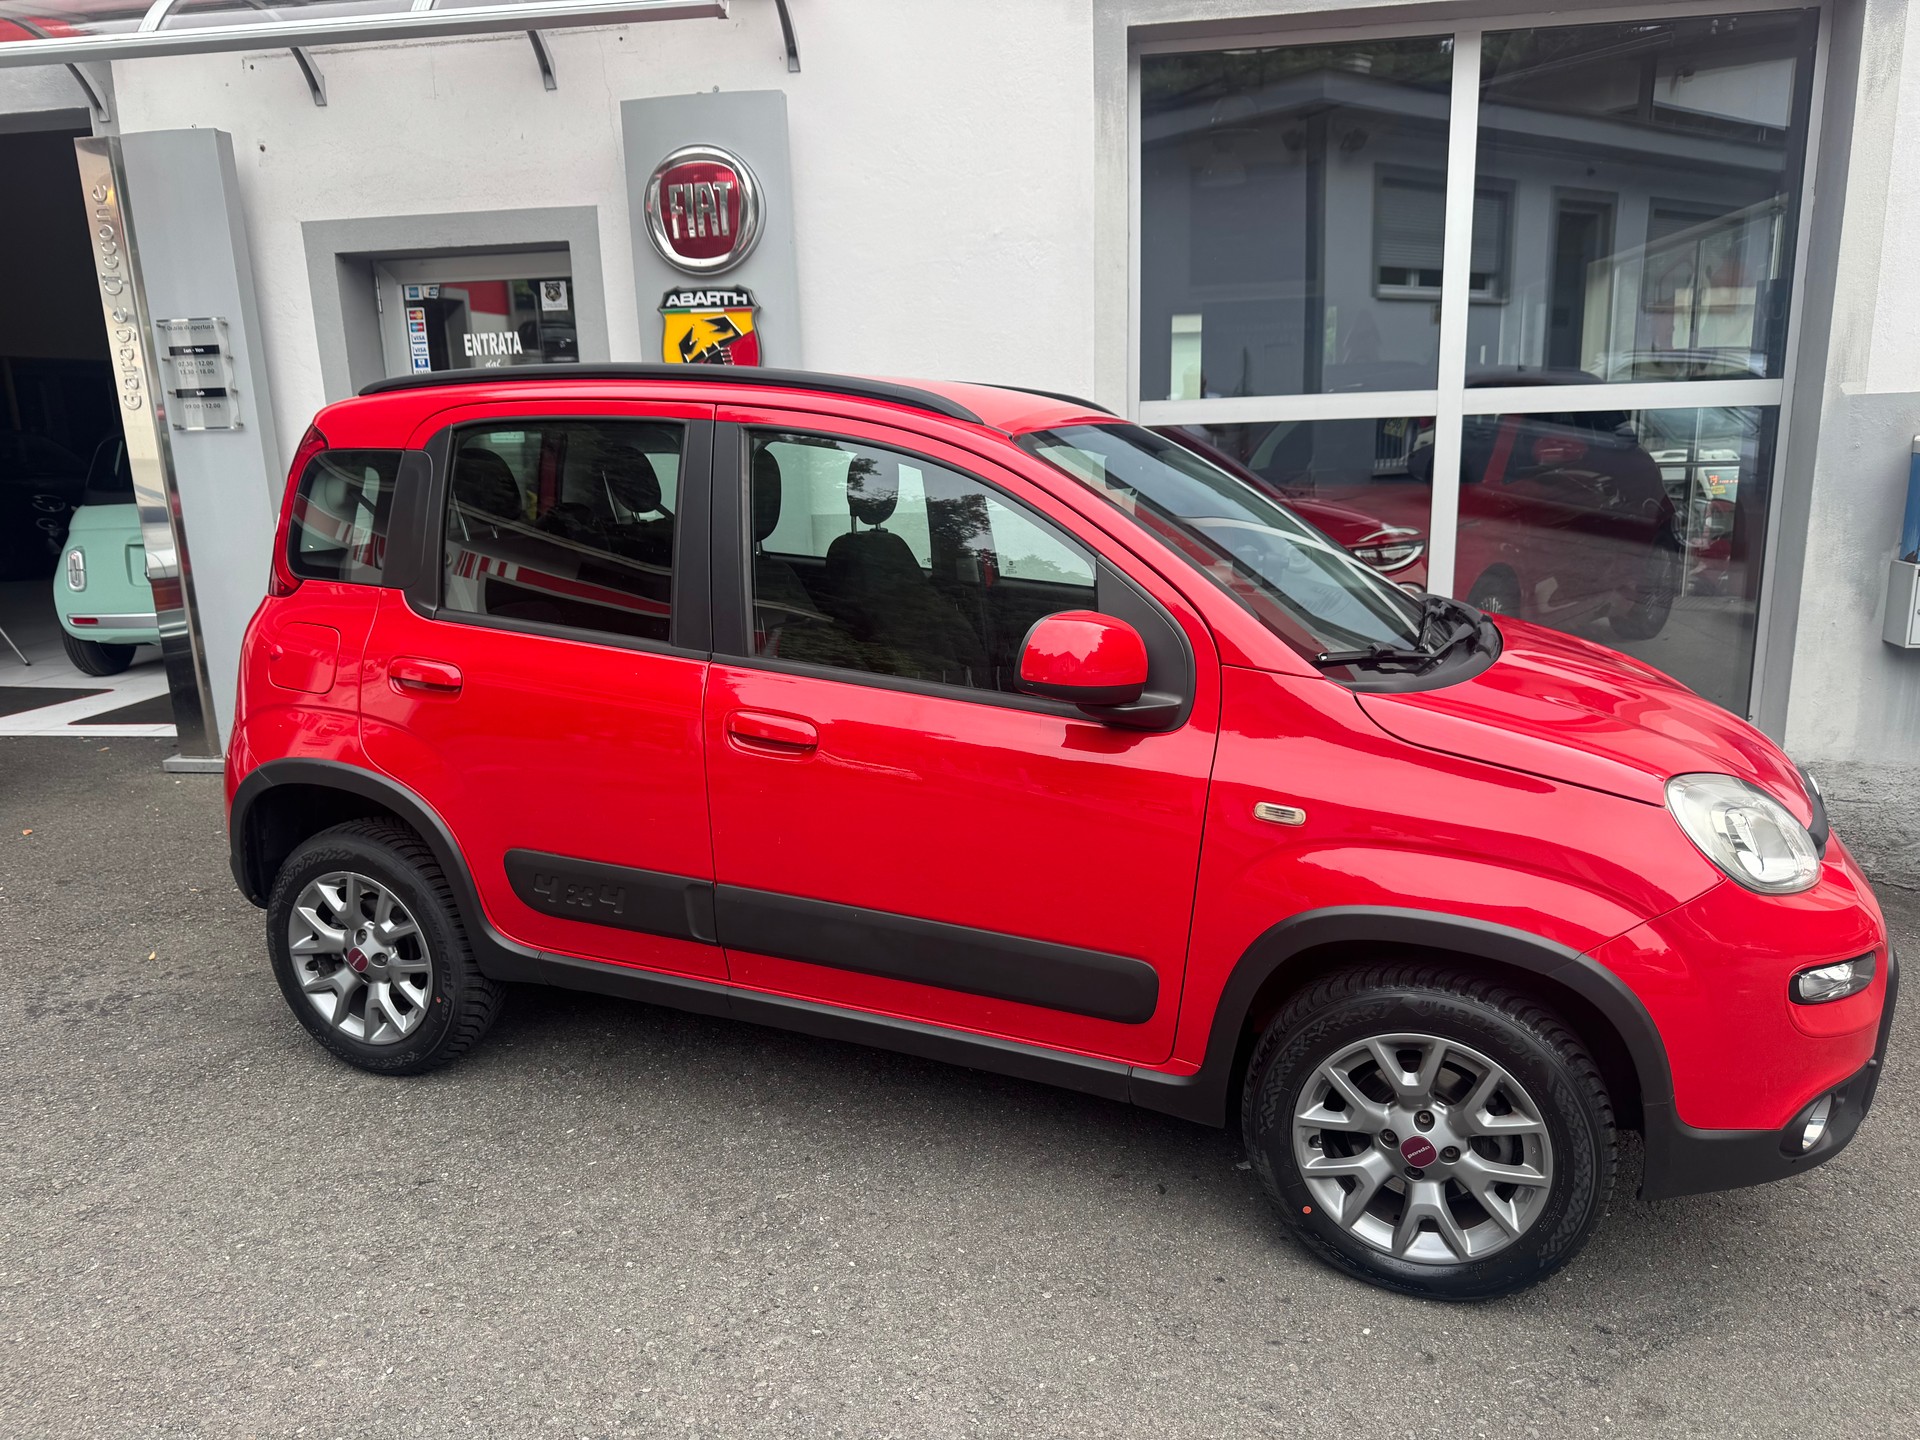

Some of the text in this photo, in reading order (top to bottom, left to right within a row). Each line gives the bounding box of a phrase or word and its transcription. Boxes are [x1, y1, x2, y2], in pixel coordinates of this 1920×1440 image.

[668, 181, 733, 239] FIAT
[666, 291, 748, 307] ABARTH
[463, 331, 523, 357] ENTRATA
[112, 306, 142, 411] Garage
[1407, 1145, 1431, 1159] panda
